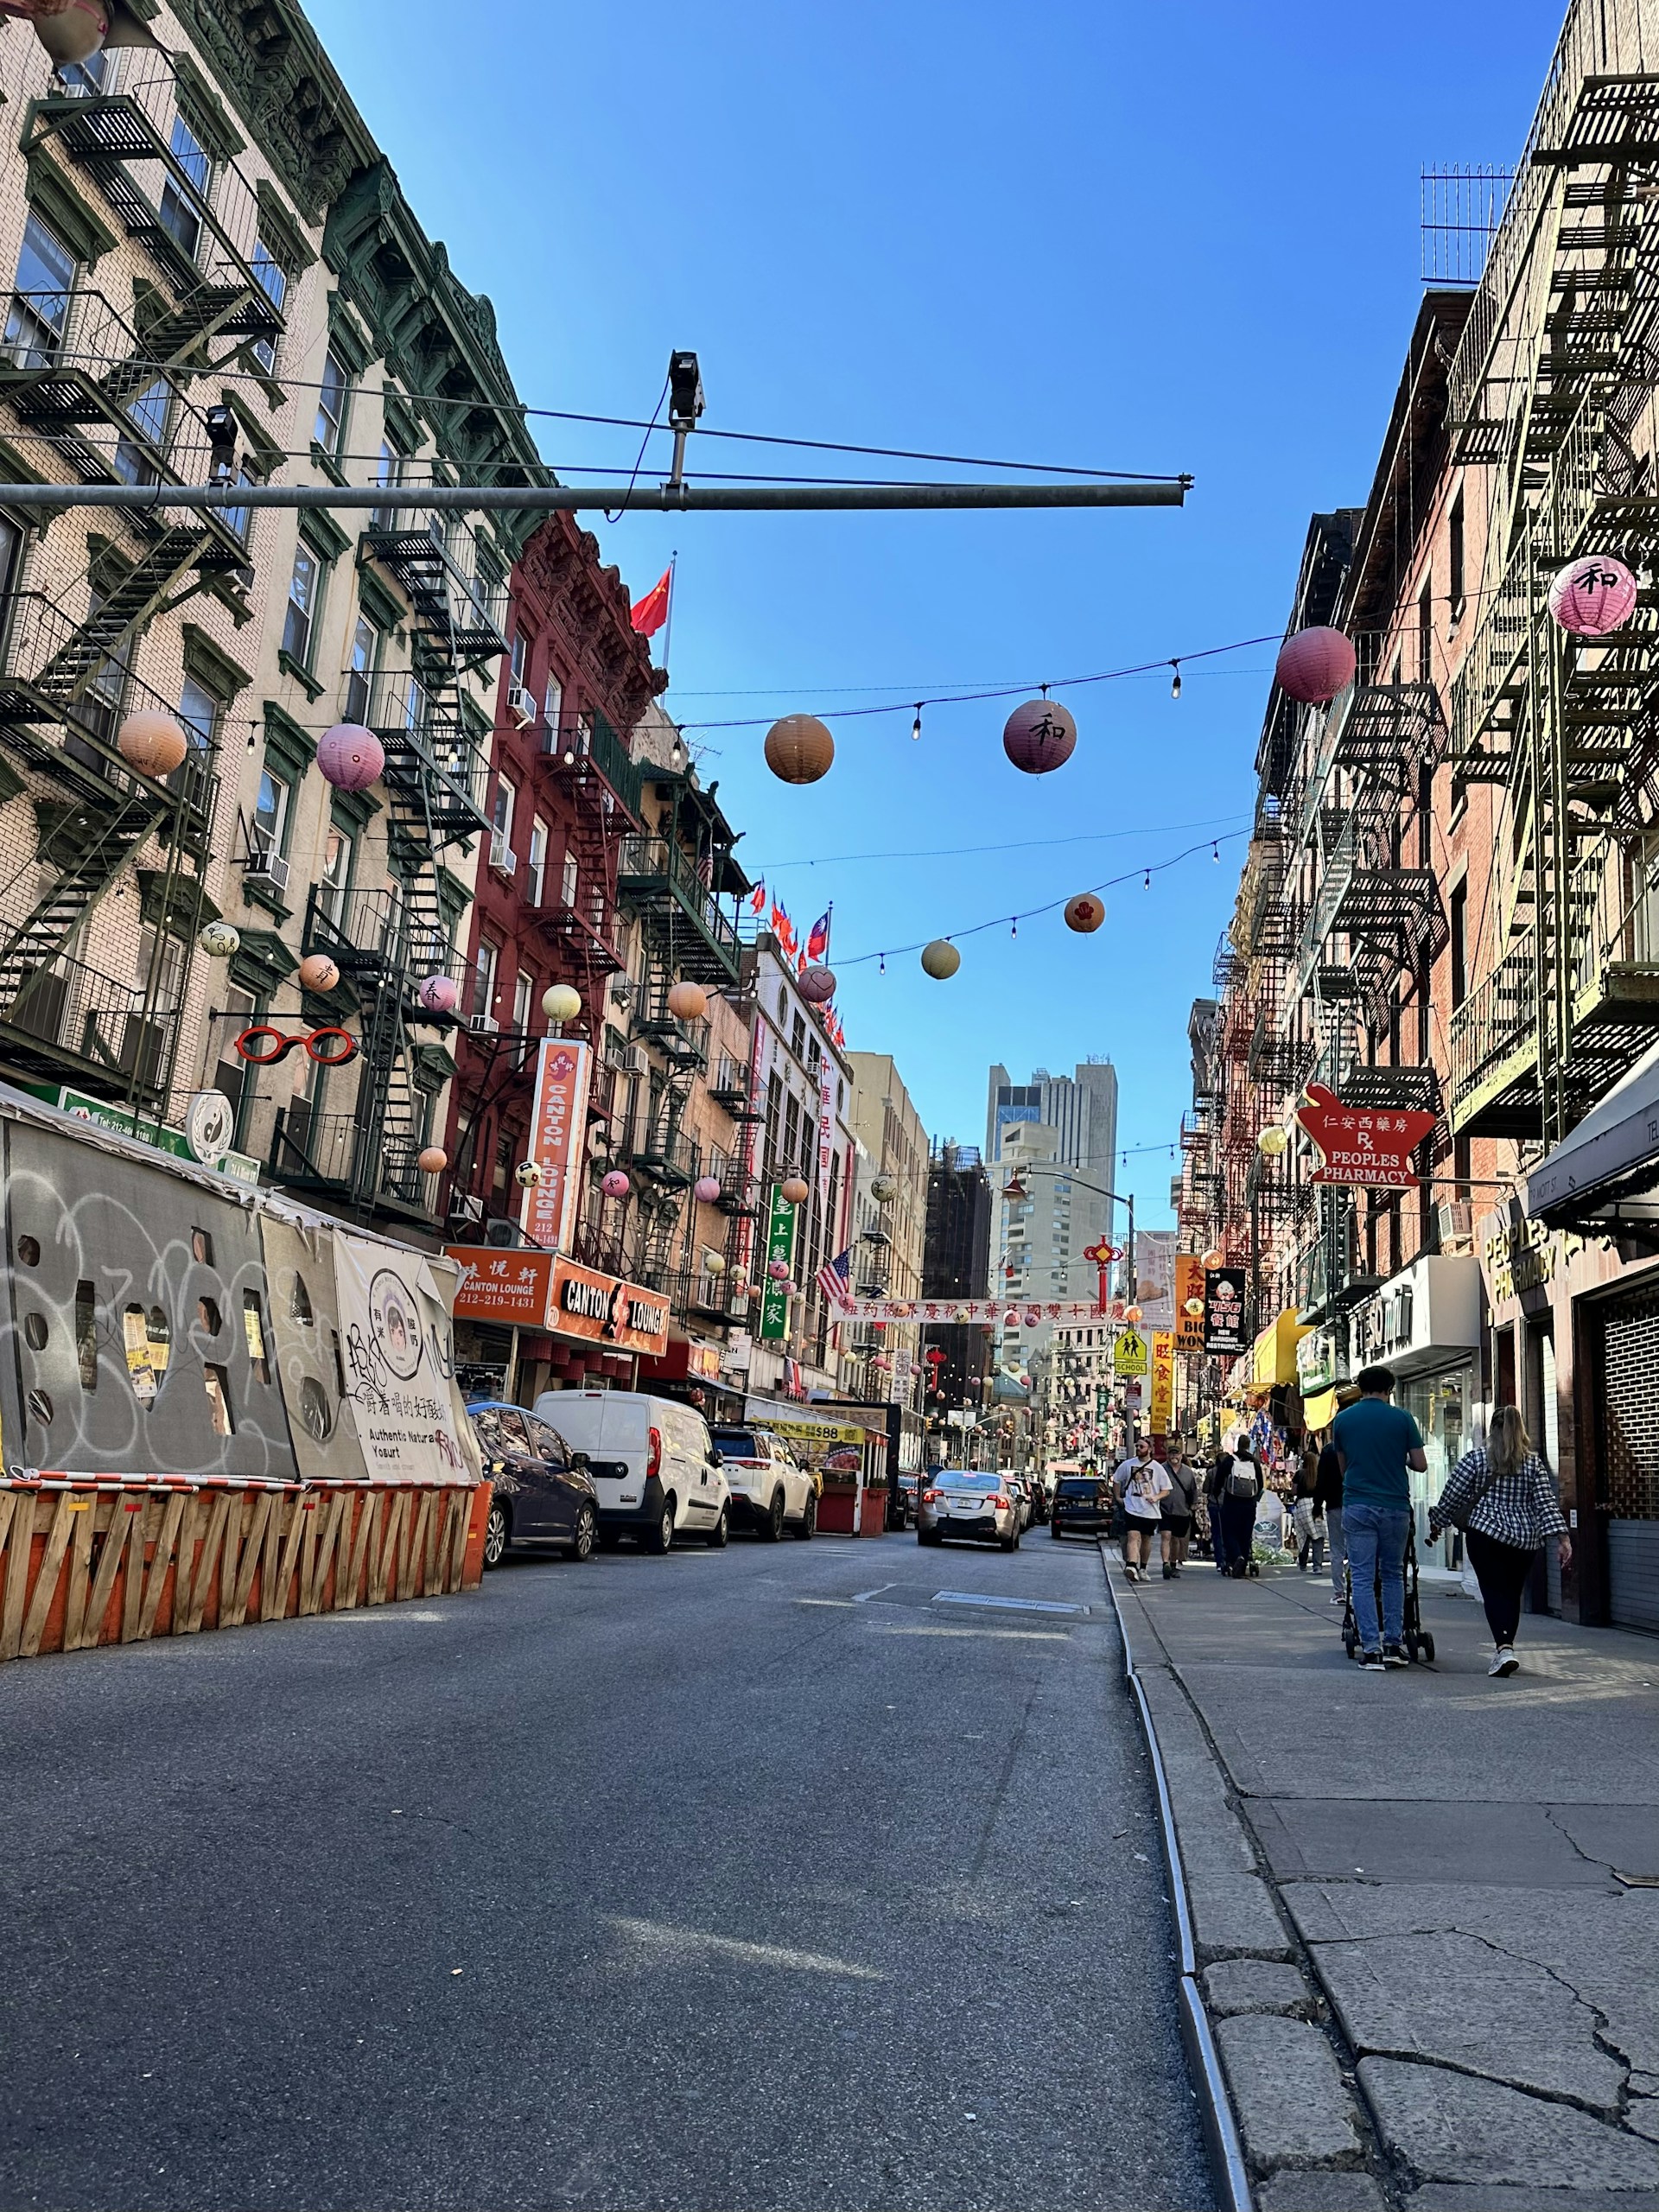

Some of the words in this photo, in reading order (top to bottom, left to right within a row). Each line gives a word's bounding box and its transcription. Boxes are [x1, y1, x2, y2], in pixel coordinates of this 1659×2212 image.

[1573, 563, 1618, 594] 和
[1029, 712, 1066, 746] 和
[543, 1084, 568, 1147] CANTON
[1323, 1115, 1408, 1134] 仁安西藥房
[1332, 1151, 1400, 1166] PEOPLES
[1323, 1166, 1408, 1185] PHARMACY
[536, 1156, 559, 1219] LOUNGE
[535, 1223, 552, 1233] 212
[1495, 1246, 1555, 1303] PHARMACY
[463, 1281, 498, 1294] CANTON
[499, 1282, 535, 1295] LOUNGE
[460, 1293, 535, 1309] 212-219-1431
[566, 1280, 610, 1321] CANTON
[632, 1301, 664, 1336] LOUNGE
[1116, 1363, 1145, 1372] SCHOOL
[369, 1428, 407, 1442] Authentic
